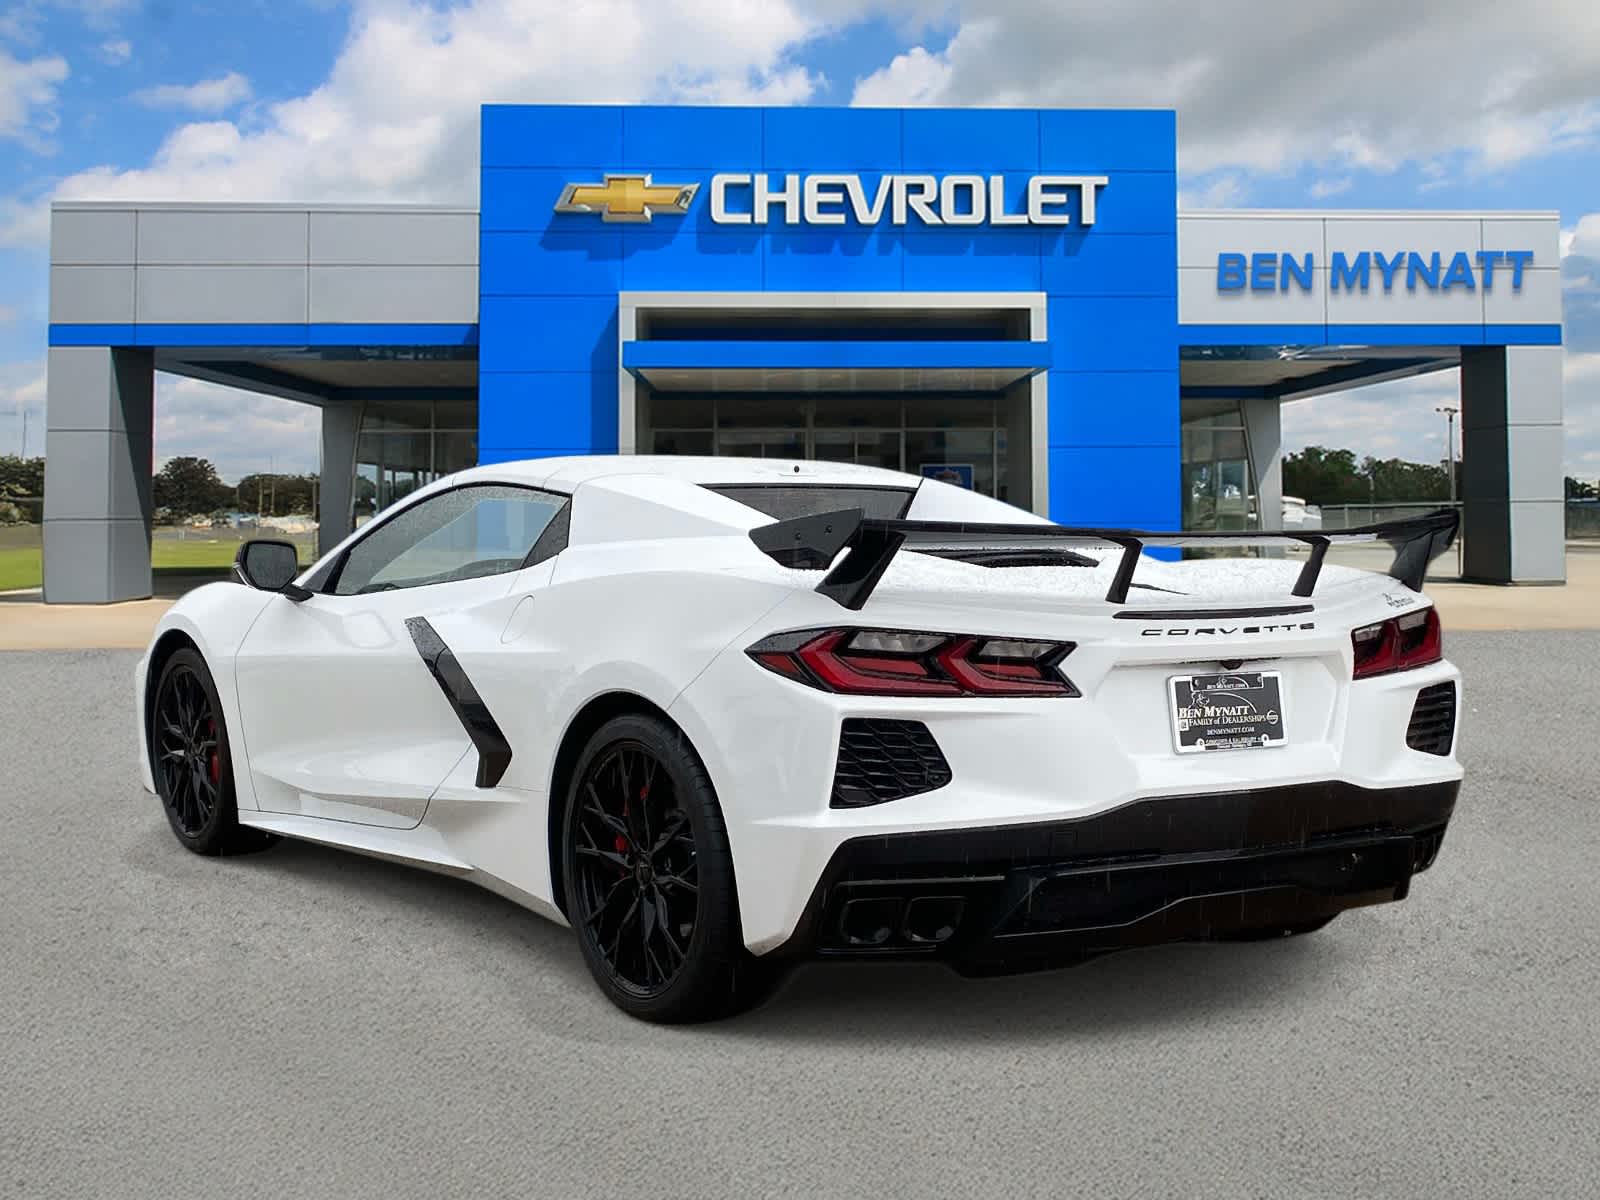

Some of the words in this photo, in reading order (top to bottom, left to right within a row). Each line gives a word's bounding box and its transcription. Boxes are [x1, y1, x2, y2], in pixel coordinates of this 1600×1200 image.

[710, 173, 1109, 226] CHEVROLET
[1217, 252, 1313, 290] BEN
[1330, 250, 1534, 290] MYNATT
[1141, 622, 1315, 636] CORVETTE
[1179, 708, 1201, 718] BEN
[1204, 705, 1250, 717] MYNATT
[1189, 718, 1212, 726] FAMILY
[1222, 715, 1266, 724] DEALERSHIPS
[1206, 727, 1255, 735] BENMYNATT.COM
